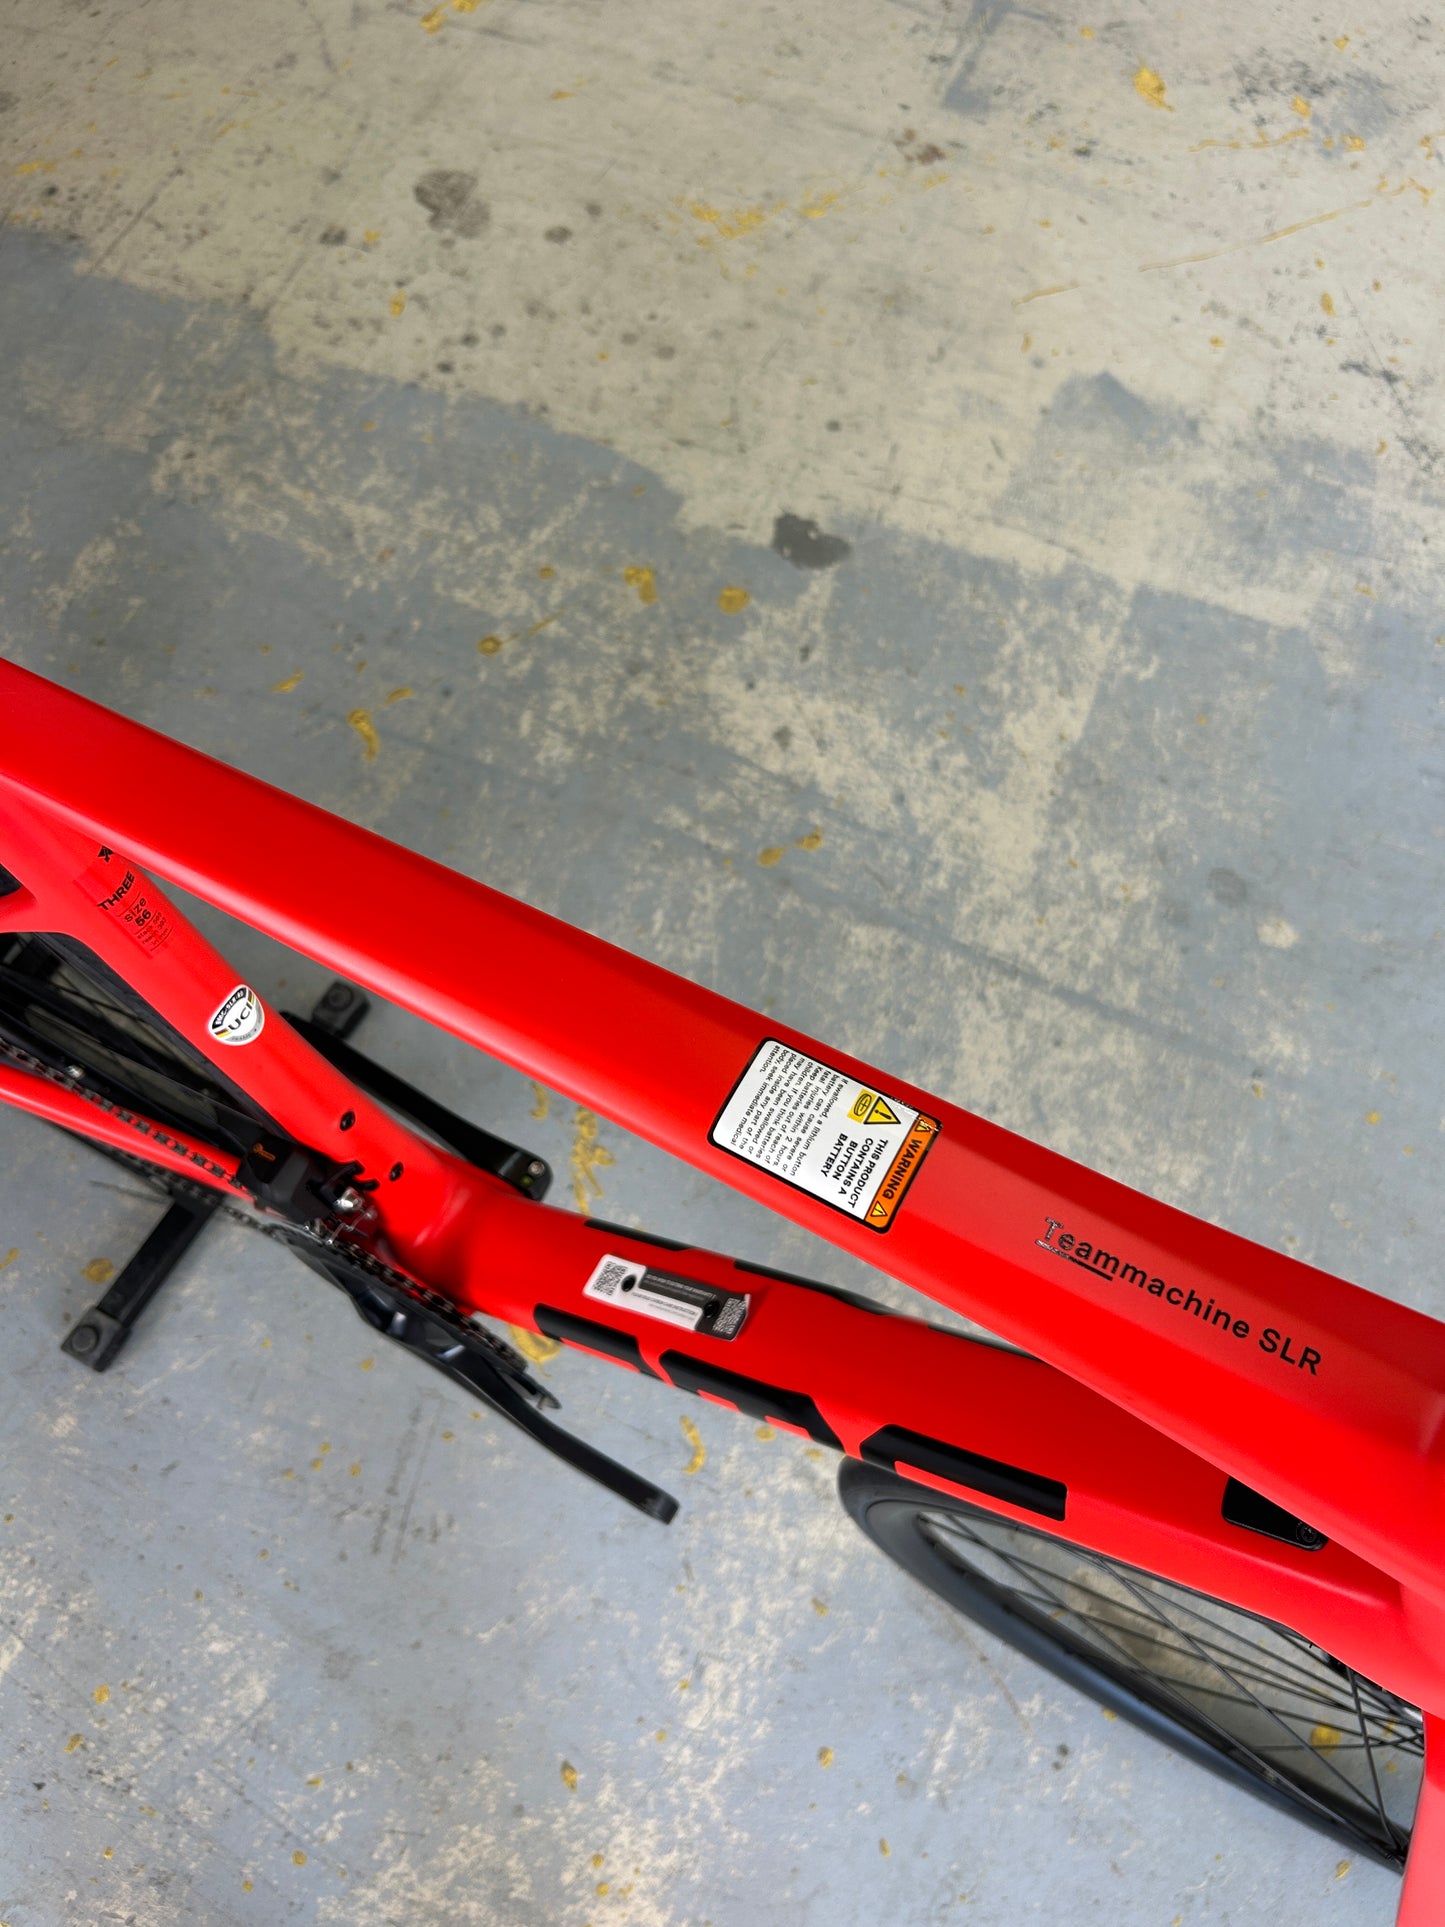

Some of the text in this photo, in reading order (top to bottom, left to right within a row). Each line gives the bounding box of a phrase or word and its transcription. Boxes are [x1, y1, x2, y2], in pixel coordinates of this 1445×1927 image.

[97, 871, 135, 910] THREE
[125, 898, 147, 922] size
[135, 909, 151, 926] 56
[228, 1003, 253, 1030] UCI
[761, 1045, 780, 1074] attention.
[783, 1053, 797, 1073] placed
[794, 1057, 805, 1070] may
[785, 1072, 797, 1087] have
[796, 1061, 813, 1087] children.
[809, 1065, 822, 1081] Keep
[820, 1070, 831, 1083] fatal
[770, 1075, 784, 1095] inside
[822, 1074, 839, 1096] battery
[731, 1049, 789, 1145] body, seek immediate medical
[761, 1096, 771, 1108] any
[774, 1089, 786, 1106] been
[784, 1094, 793, 1106] you
[793, 1082, 812, 1111] batteries
[803, 1085, 821, 1110] injuries
[814, 1099, 824, 1111] can
[820, 1084, 844, 1119] swallowed,
[751, 1111, 762, 1125] part
[753, 1108, 775, 1143] swallowed
[774, 1109, 786, 1125] think
[786, 1112, 795, 1123] out
[791, 1112, 806, 1133] within
[802, 1114, 815, 1134] cause
[739, 1138, 748, 1149] the
[755, 1127, 776, 1158] batteries
[769, 1134, 783, 1153] reach
[787, 1137, 802, 1160] severe
[804, 1127, 820, 1150] lithium
[772, 1145, 788, 1167] hours.
[790, 1152, 806, 1176] button
[820, 1134, 848, 1176] BATTERY
[832, 1141, 858, 1180] BUTTON
[839, 1138, 874, 1196] CONTAINS A
[846, 1138, 888, 1207] THIS PRODUCT
[882, 1138, 922, 1200] WARNING
[1044, 1217, 1321, 1375] Teammachine SLR
